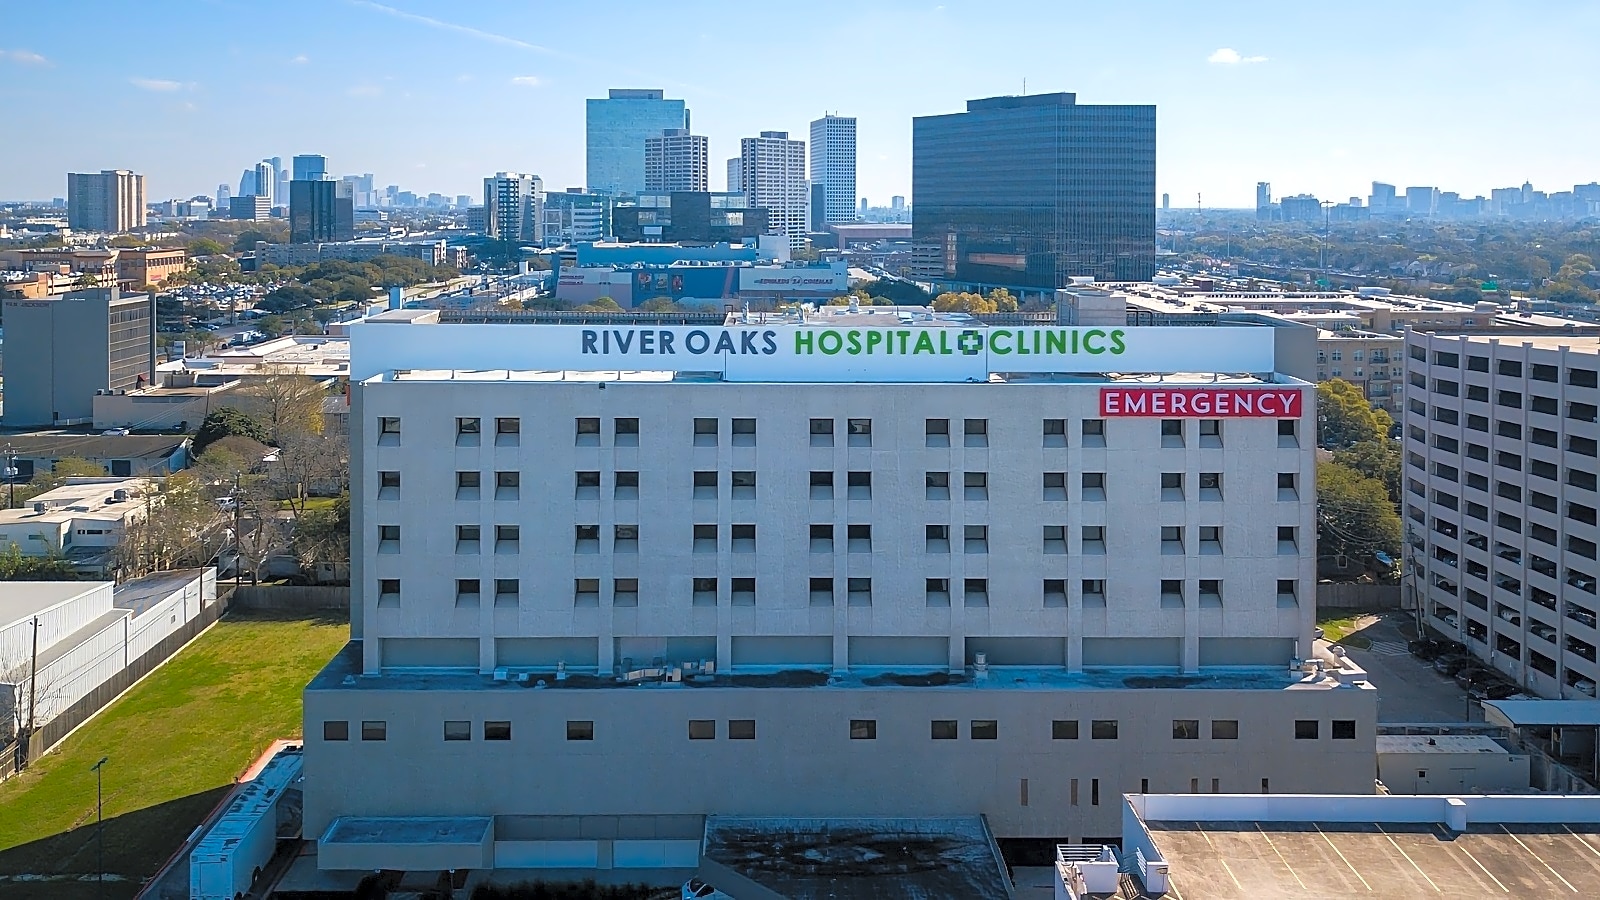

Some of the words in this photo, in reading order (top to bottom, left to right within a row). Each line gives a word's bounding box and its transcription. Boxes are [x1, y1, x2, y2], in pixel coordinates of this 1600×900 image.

[581, 329, 675, 355] RIVER
[685, 329, 778, 355] OAKS
[795, 329, 953, 356] HOSPITAL
[989, 329, 1126, 356] CLINICS
[1105, 392, 1297, 415] EMERGENCY
